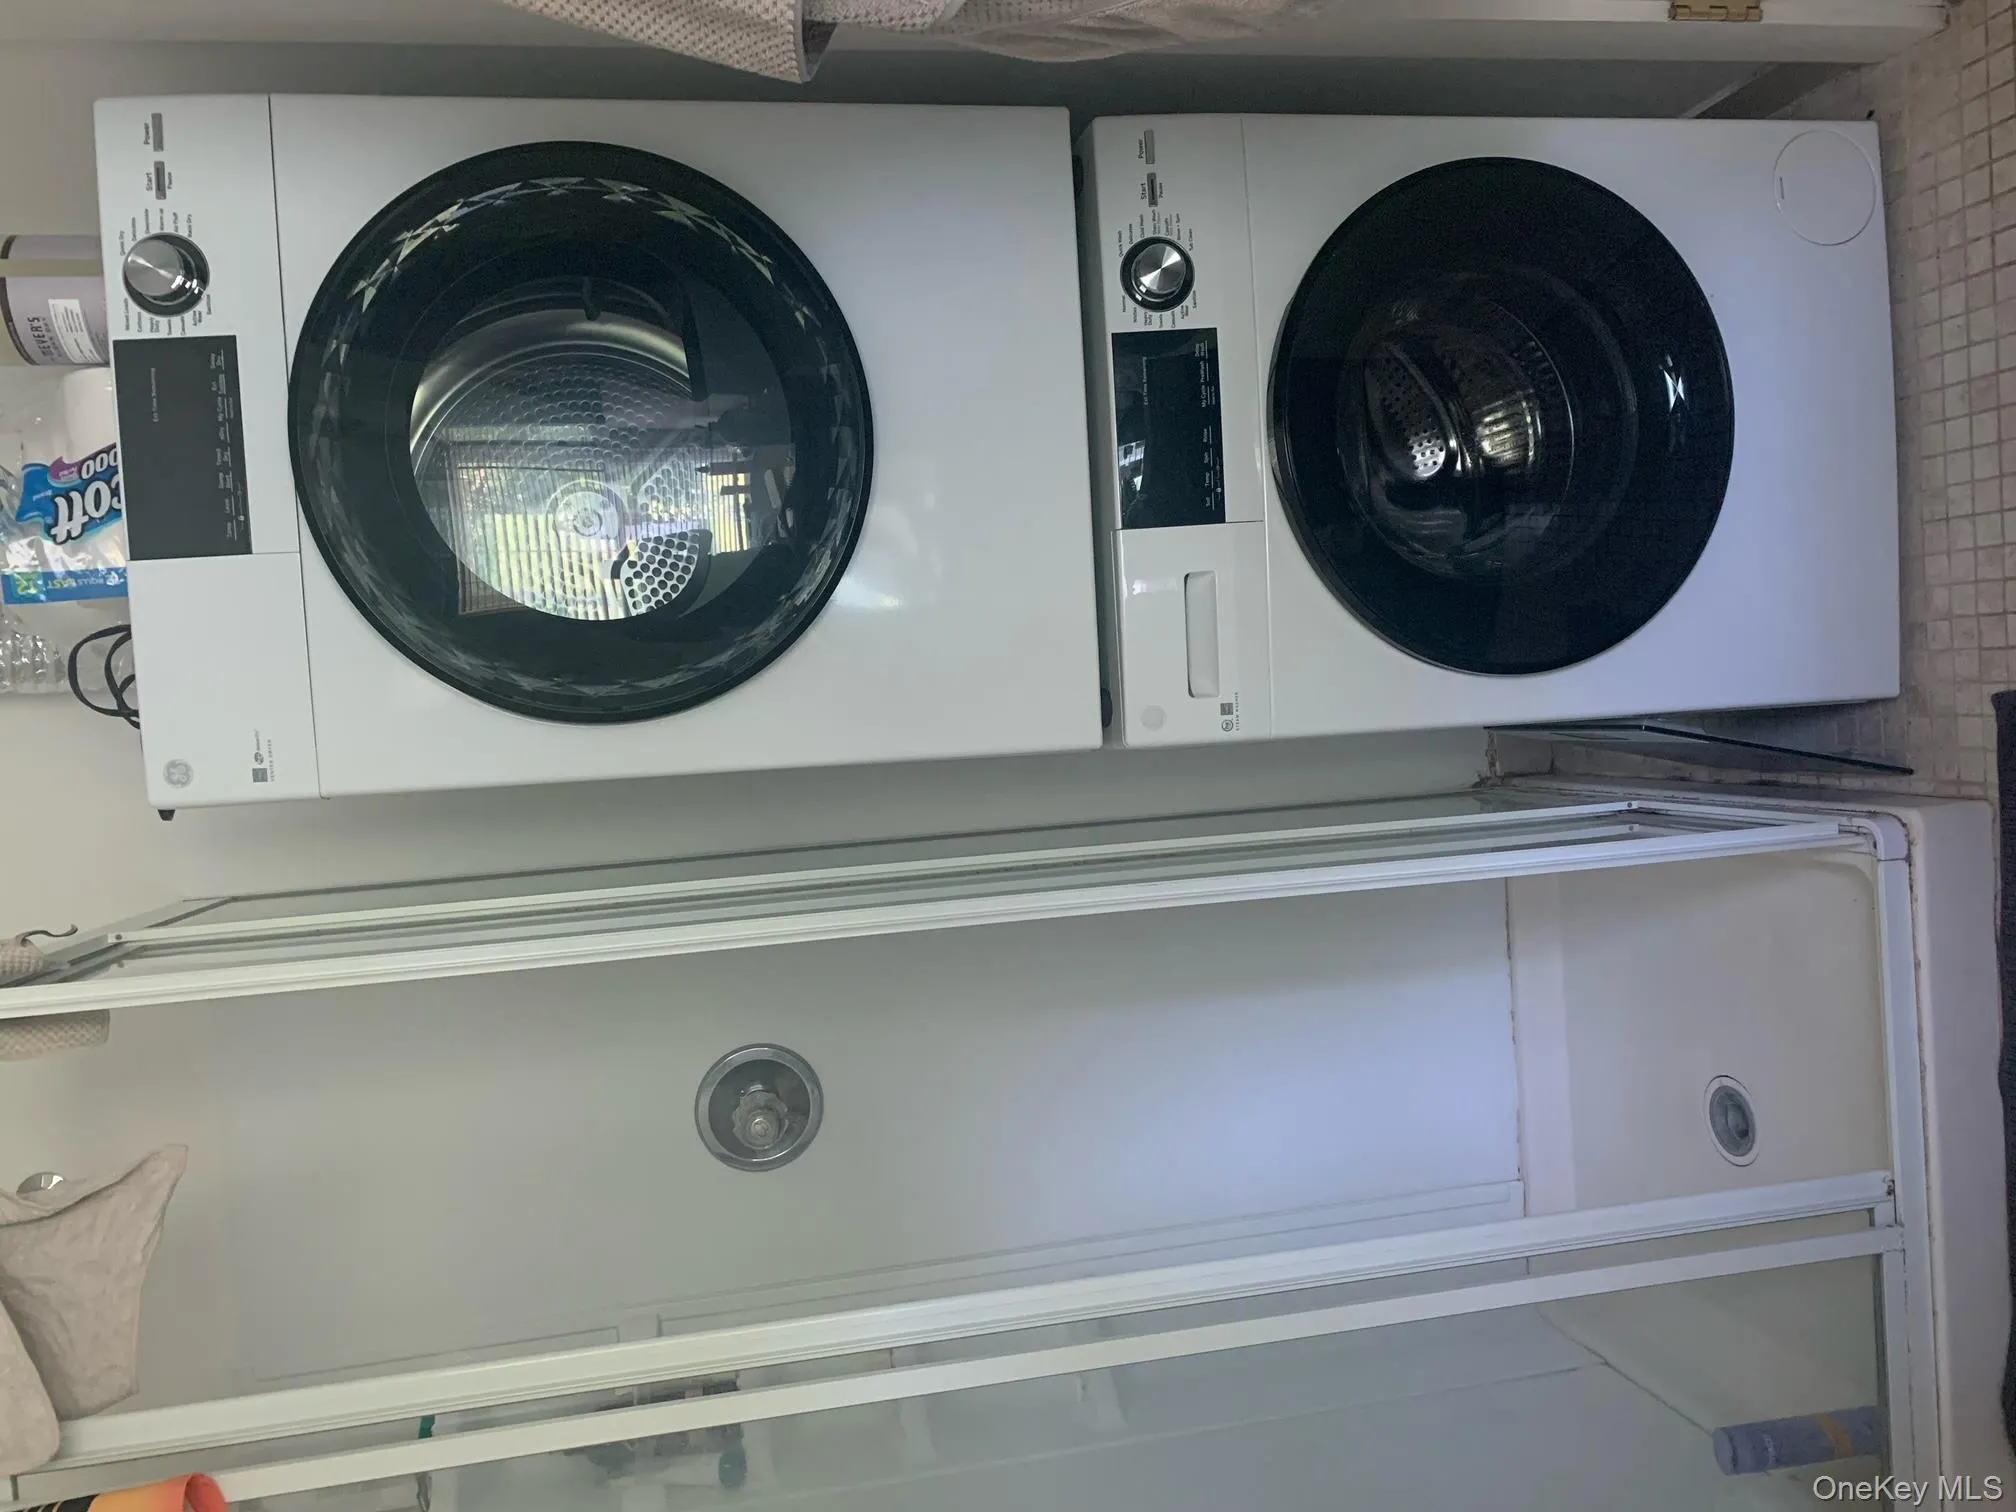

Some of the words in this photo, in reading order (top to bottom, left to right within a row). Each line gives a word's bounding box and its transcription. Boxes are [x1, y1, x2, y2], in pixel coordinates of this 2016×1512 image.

[1139, 183, 1147, 200] Start
[81, 448, 119, 480] 000
[50, 474, 122, 543] cott
